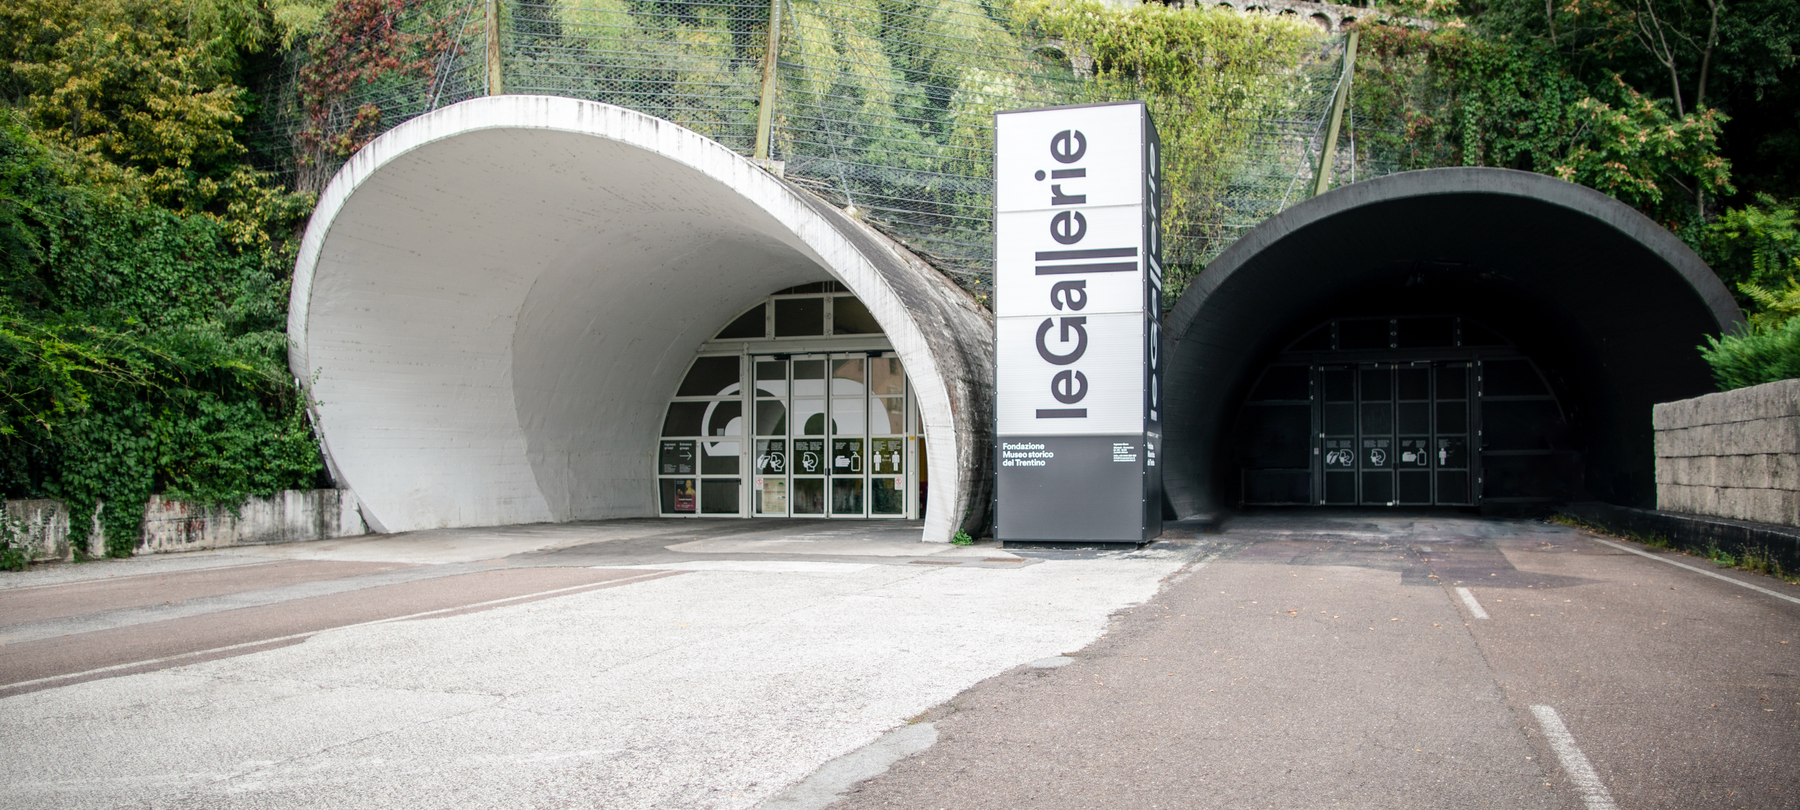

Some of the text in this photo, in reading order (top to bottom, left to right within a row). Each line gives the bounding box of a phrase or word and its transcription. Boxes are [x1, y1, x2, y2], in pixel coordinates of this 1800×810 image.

[1034, 129, 1139, 419] leGallerie
[1002, 442, 1045, 450] Fondazione
[1002, 450, 1054, 459] Museo storico
[1002, 458, 1046, 467] del Trentino
